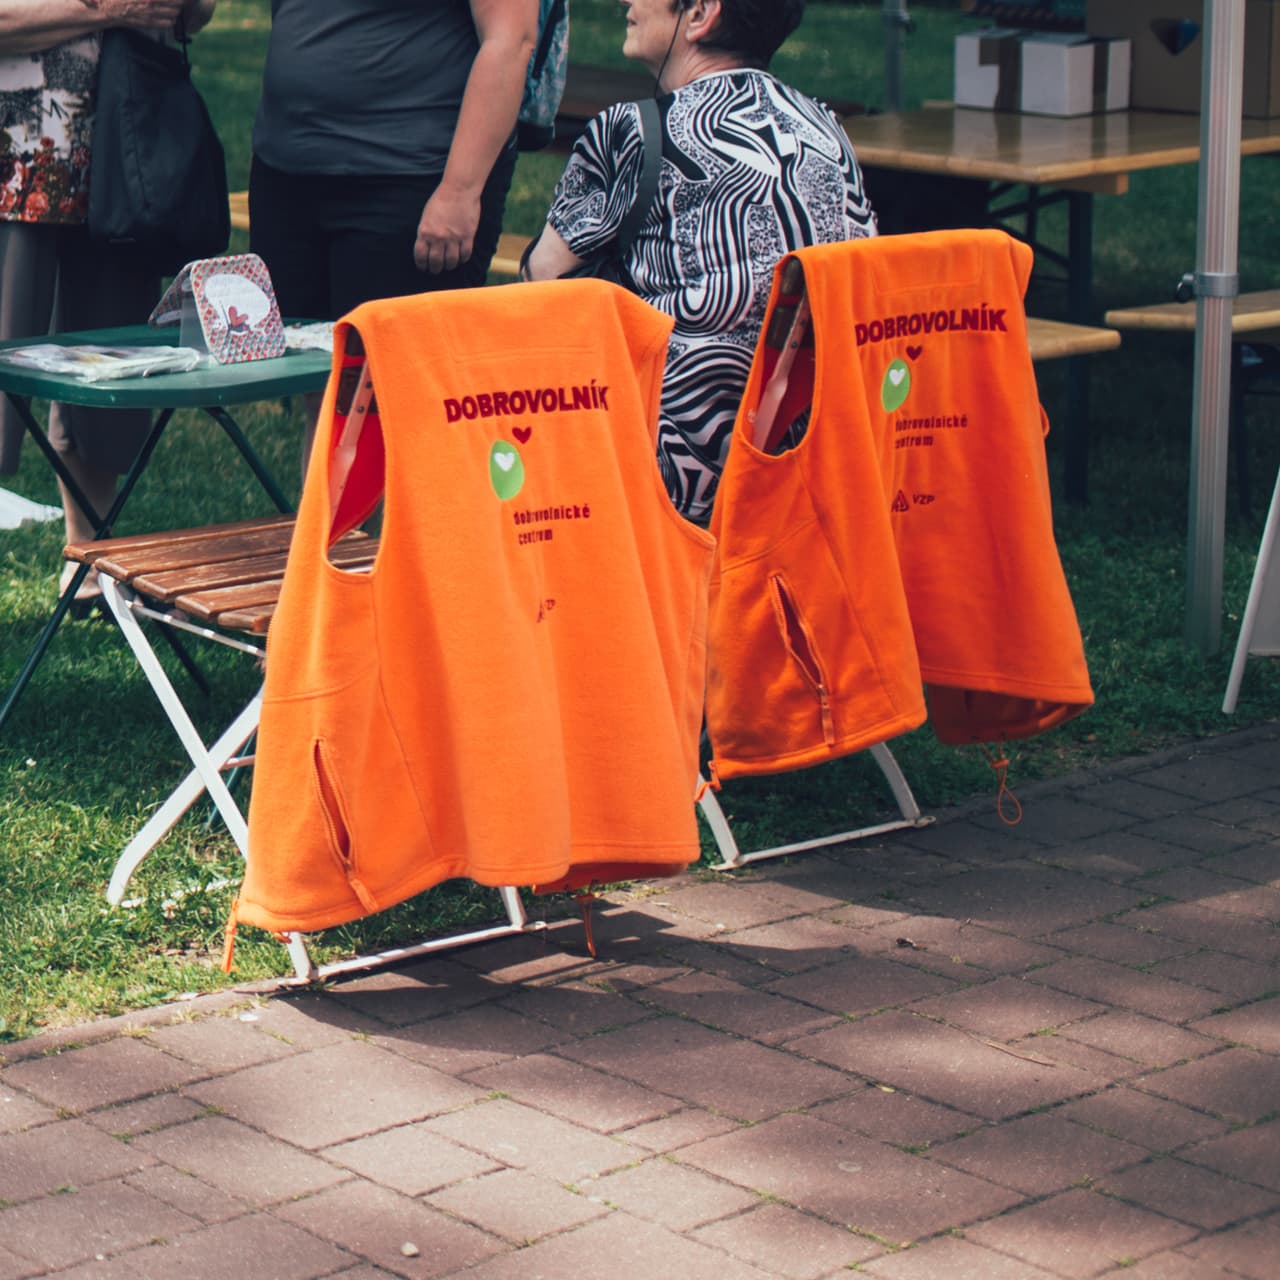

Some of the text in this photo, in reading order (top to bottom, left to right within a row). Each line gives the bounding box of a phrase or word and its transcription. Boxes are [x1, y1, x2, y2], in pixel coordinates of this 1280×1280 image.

[854, 302, 1008, 346] DOBROVOLNÍK
[443, 378, 608, 423] DOBROVOLNÍK
[895, 414, 969, 432] obrovolnické
[896, 435, 933, 449] entrum
[912, 494, 936, 505] VZP
